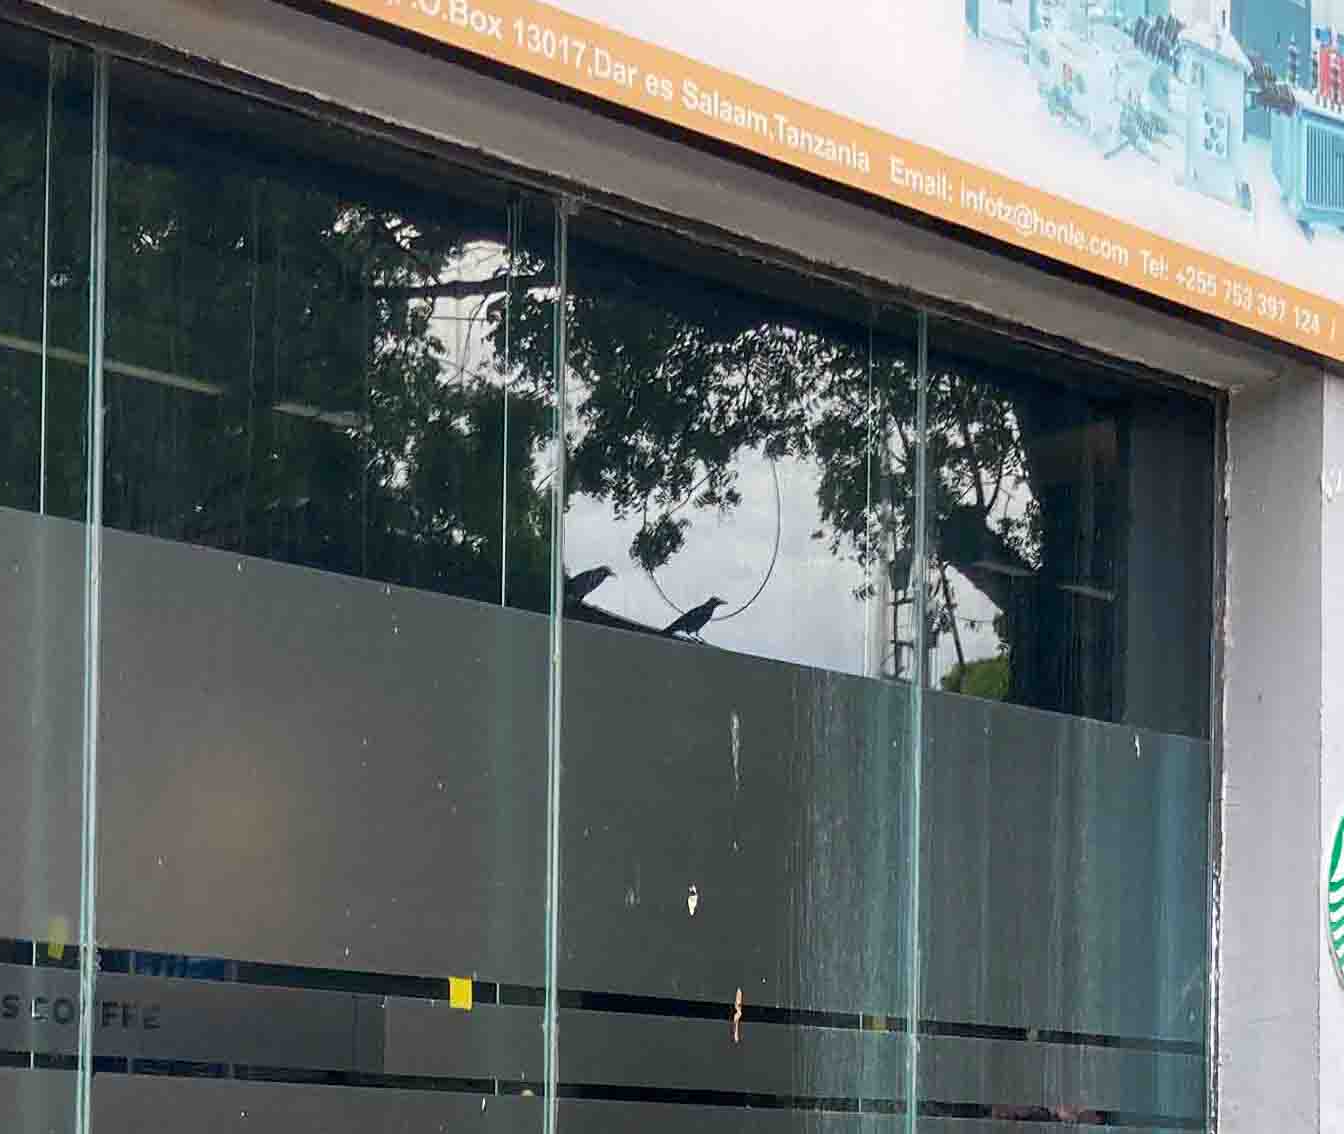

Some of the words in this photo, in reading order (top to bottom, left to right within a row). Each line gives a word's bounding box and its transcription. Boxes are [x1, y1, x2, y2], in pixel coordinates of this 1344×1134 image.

[645, 72, 672, 100] es
[890, 156, 953, 201] Email:
[1139, 249, 1169, 281] Tel:
[1175, 266, 1216, 297] +255
[1294, 306, 1321, 336] 124
